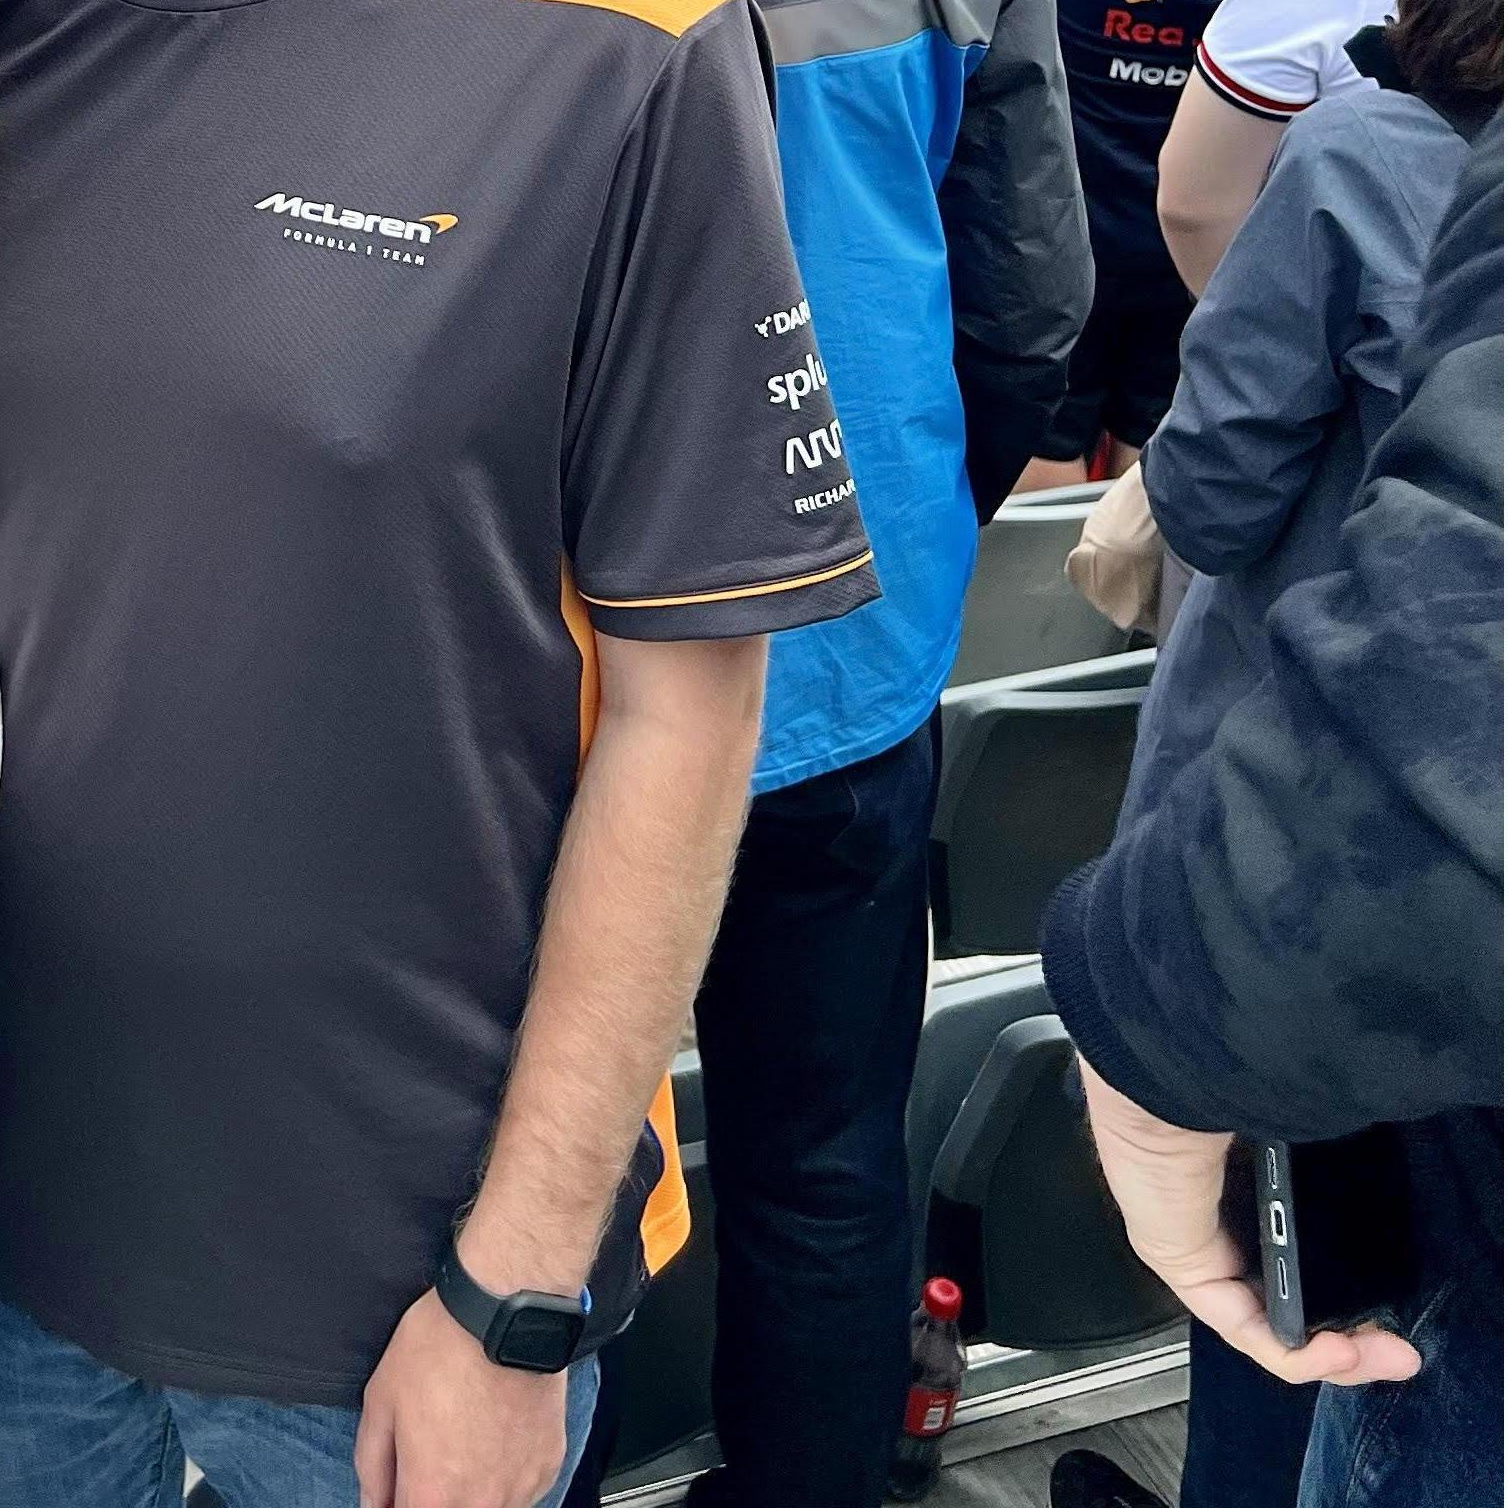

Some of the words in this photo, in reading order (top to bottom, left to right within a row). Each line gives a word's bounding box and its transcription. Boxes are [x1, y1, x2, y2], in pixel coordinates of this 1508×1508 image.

[254, 192, 433, 244] McLaren
[283, 228, 357, 253] FORMULA
[382, 247, 425, 266] TEAM
